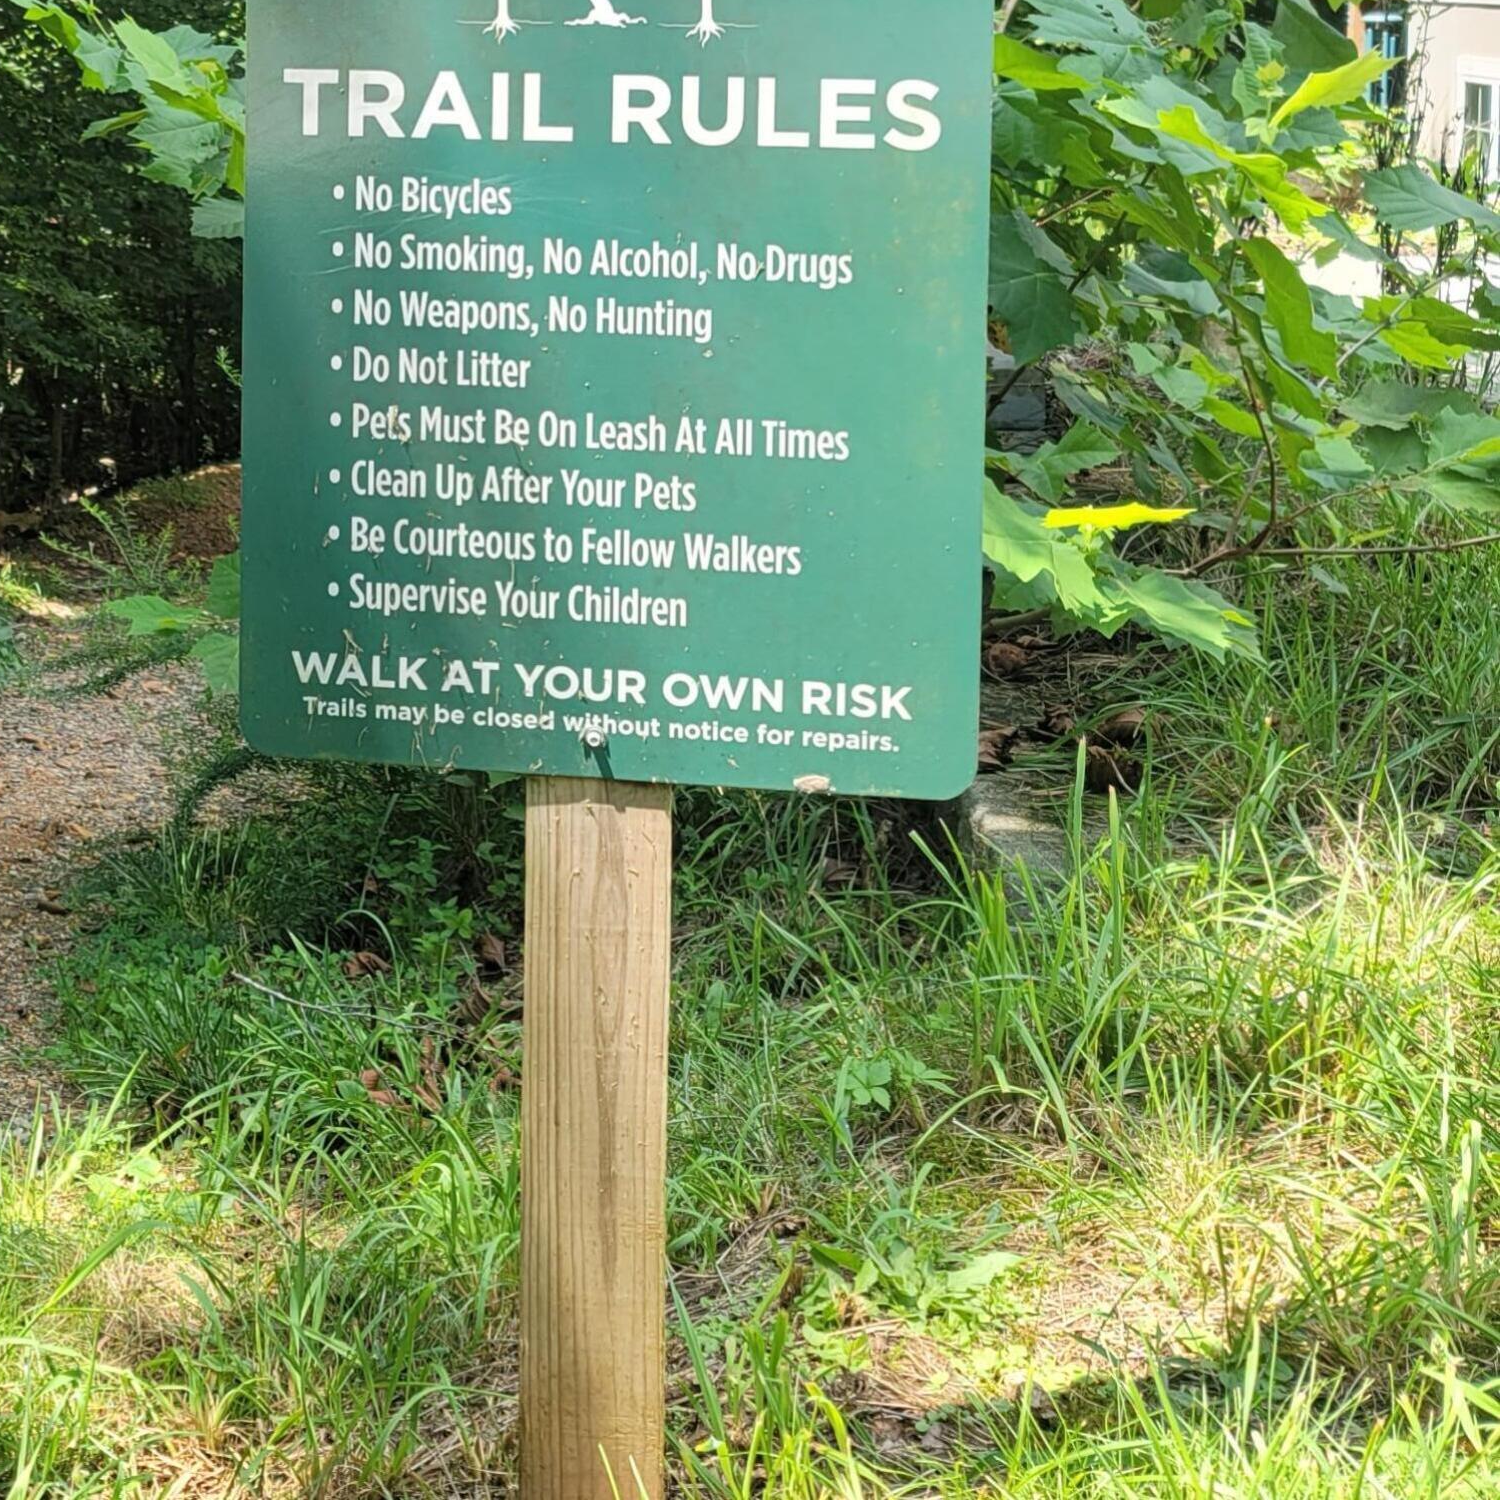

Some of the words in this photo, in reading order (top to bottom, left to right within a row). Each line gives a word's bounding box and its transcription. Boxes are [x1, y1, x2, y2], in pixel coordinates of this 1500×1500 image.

[283, 68, 574, 142] TRAIL
[611, 74, 942, 151] RULES
[355, 176, 393, 212] No
[401, 176, 512, 220] Bicycles
[354, 232, 392, 269] No
[400, 233, 534, 280] Smoking,
[543, 237, 582, 275] No
[590, 239, 708, 286] Alcohol,
[717, 242, 758, 281] No
[765, 244, 853, 290] Drugs
[353, 288, 392, 326] No
[399, 290, 539, 338] Weapons,
[548, 295, 587, 333] No
[596, 297, 712, 344] Hunting
[353, 345, 390, 383] Do
[398, 347, 448, 385] Not
[456, 350, 531, 388] Litter
[352, 402, 412, 443] Pets
[420, 405, 486, 444] Must
[494, 408, 530, 447] Be
[538, 410, 577, 448] On
[585, 412, 667, 452] Leash
[674, 416, 707, 454] At
[714, 418, 753, 456] All
[761, 419, 850, 461] Times
[351, 459, 427, 498] Clean
[435, 463, 474, 506] Up
[481, 465, 554, 504] After
[560, 468, 627, 508] Your
[634, 472, 697, 512] Pets
[351, 516, 386, 553] Be
[393, 518, 536, 561] Courteous
[543, 527, 573, 563] to
[582, 527, 676, 569] Fellow
[683, 532, 802, 575] Walkers
[349, 572, 488, 617] Supervise
[494, 580, 560, 620] Your
[568, 584, 687, 627] Children
[291, 650, 428, 691] WALK
[441, 658, 500, 695] AT
[514, 663, 646, 705] YOUR
[662, 672, 784, 713] OWN
[802, 680, 912, 721] RISK
[302, 695, 367, 718] Trails
[375, 702, 428, 726] may
[434, 703, 465, 725] be
[472, 706, 555, 731] closed
[562, 712, 661, 740] without
[668, 720, 749, 743] notice
[756, 723, 795, 746] for
[802, 727, 901, 755] repairs.
